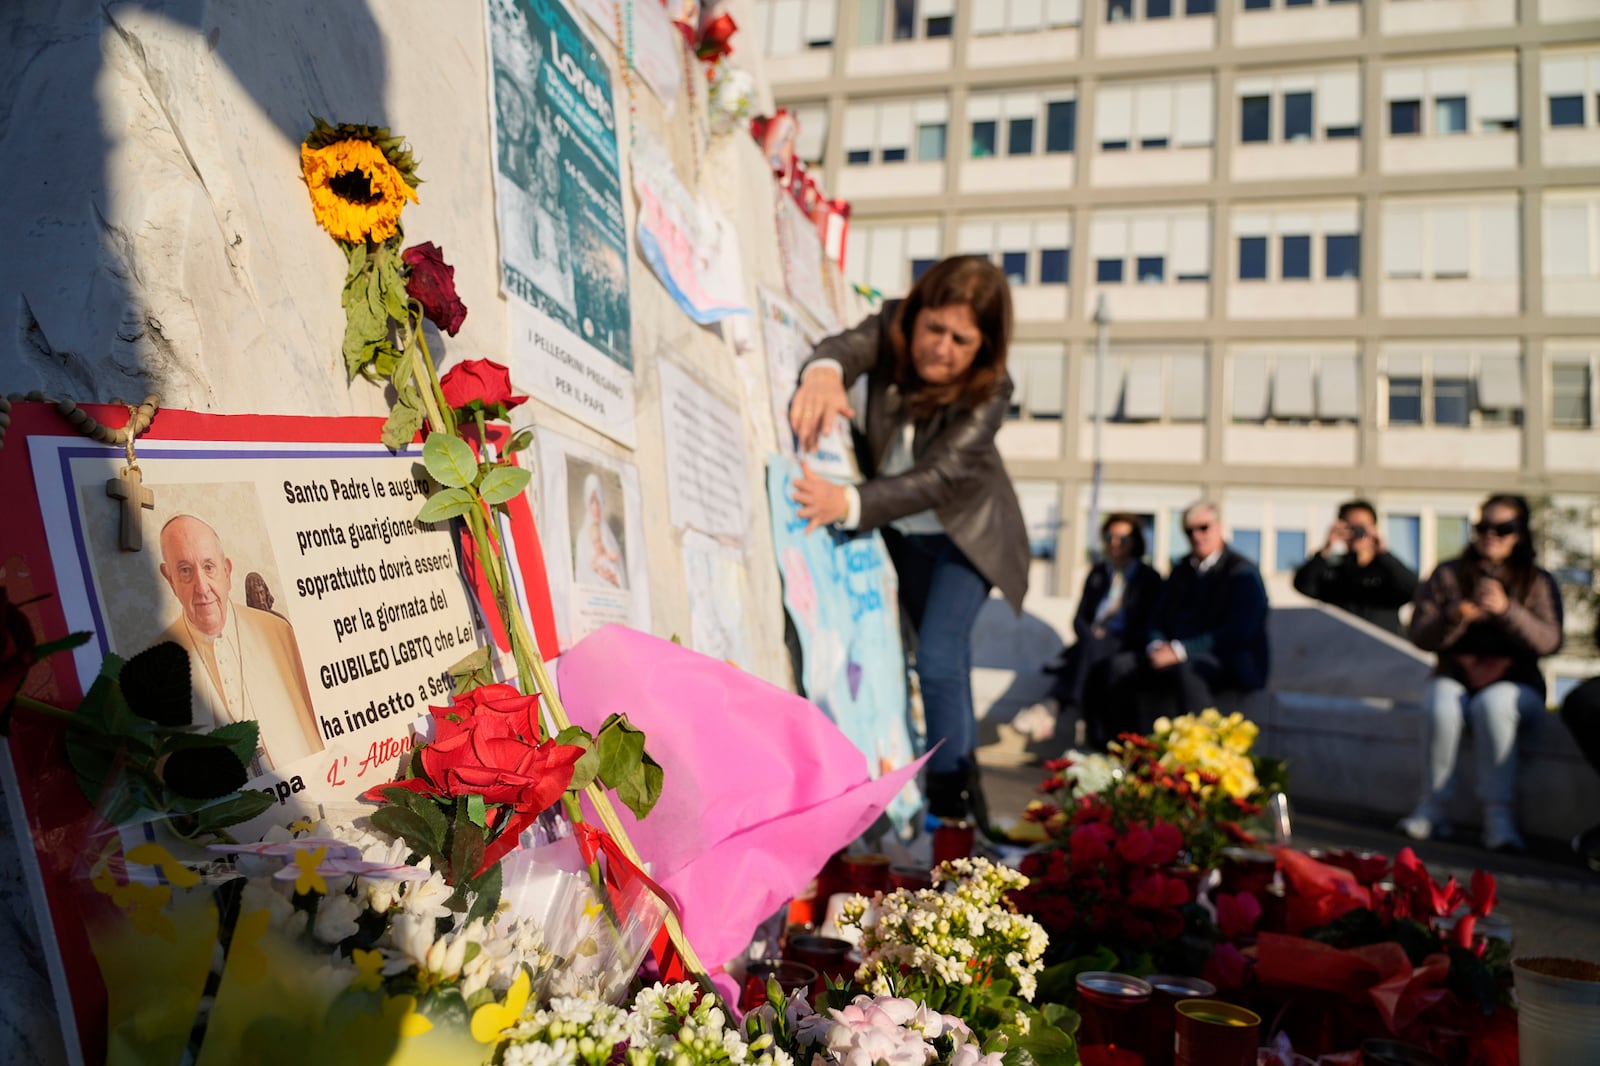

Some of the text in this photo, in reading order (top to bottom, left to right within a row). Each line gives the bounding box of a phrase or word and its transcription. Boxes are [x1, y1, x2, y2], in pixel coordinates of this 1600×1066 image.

[534, 332, 585, 377] PELLEGRINI
[555, 376, 575, 396] PER
[584, 392, 606, 416] PAPA
[283, 477, 430, 504] Santo Padre le auguro
[296, 523, 346, 555] pronta
[296, 549, 453, 600] soprattutto dovrà esserci
[333, 588, 449, 642] per la giornata del
[320, 621, 474, 689] GIUBILEO LGBTQ che Lei
[320, 710, 345, 740] ha
[343, 692, 415, 732] indetto
[418, 684, 428, 701] a
